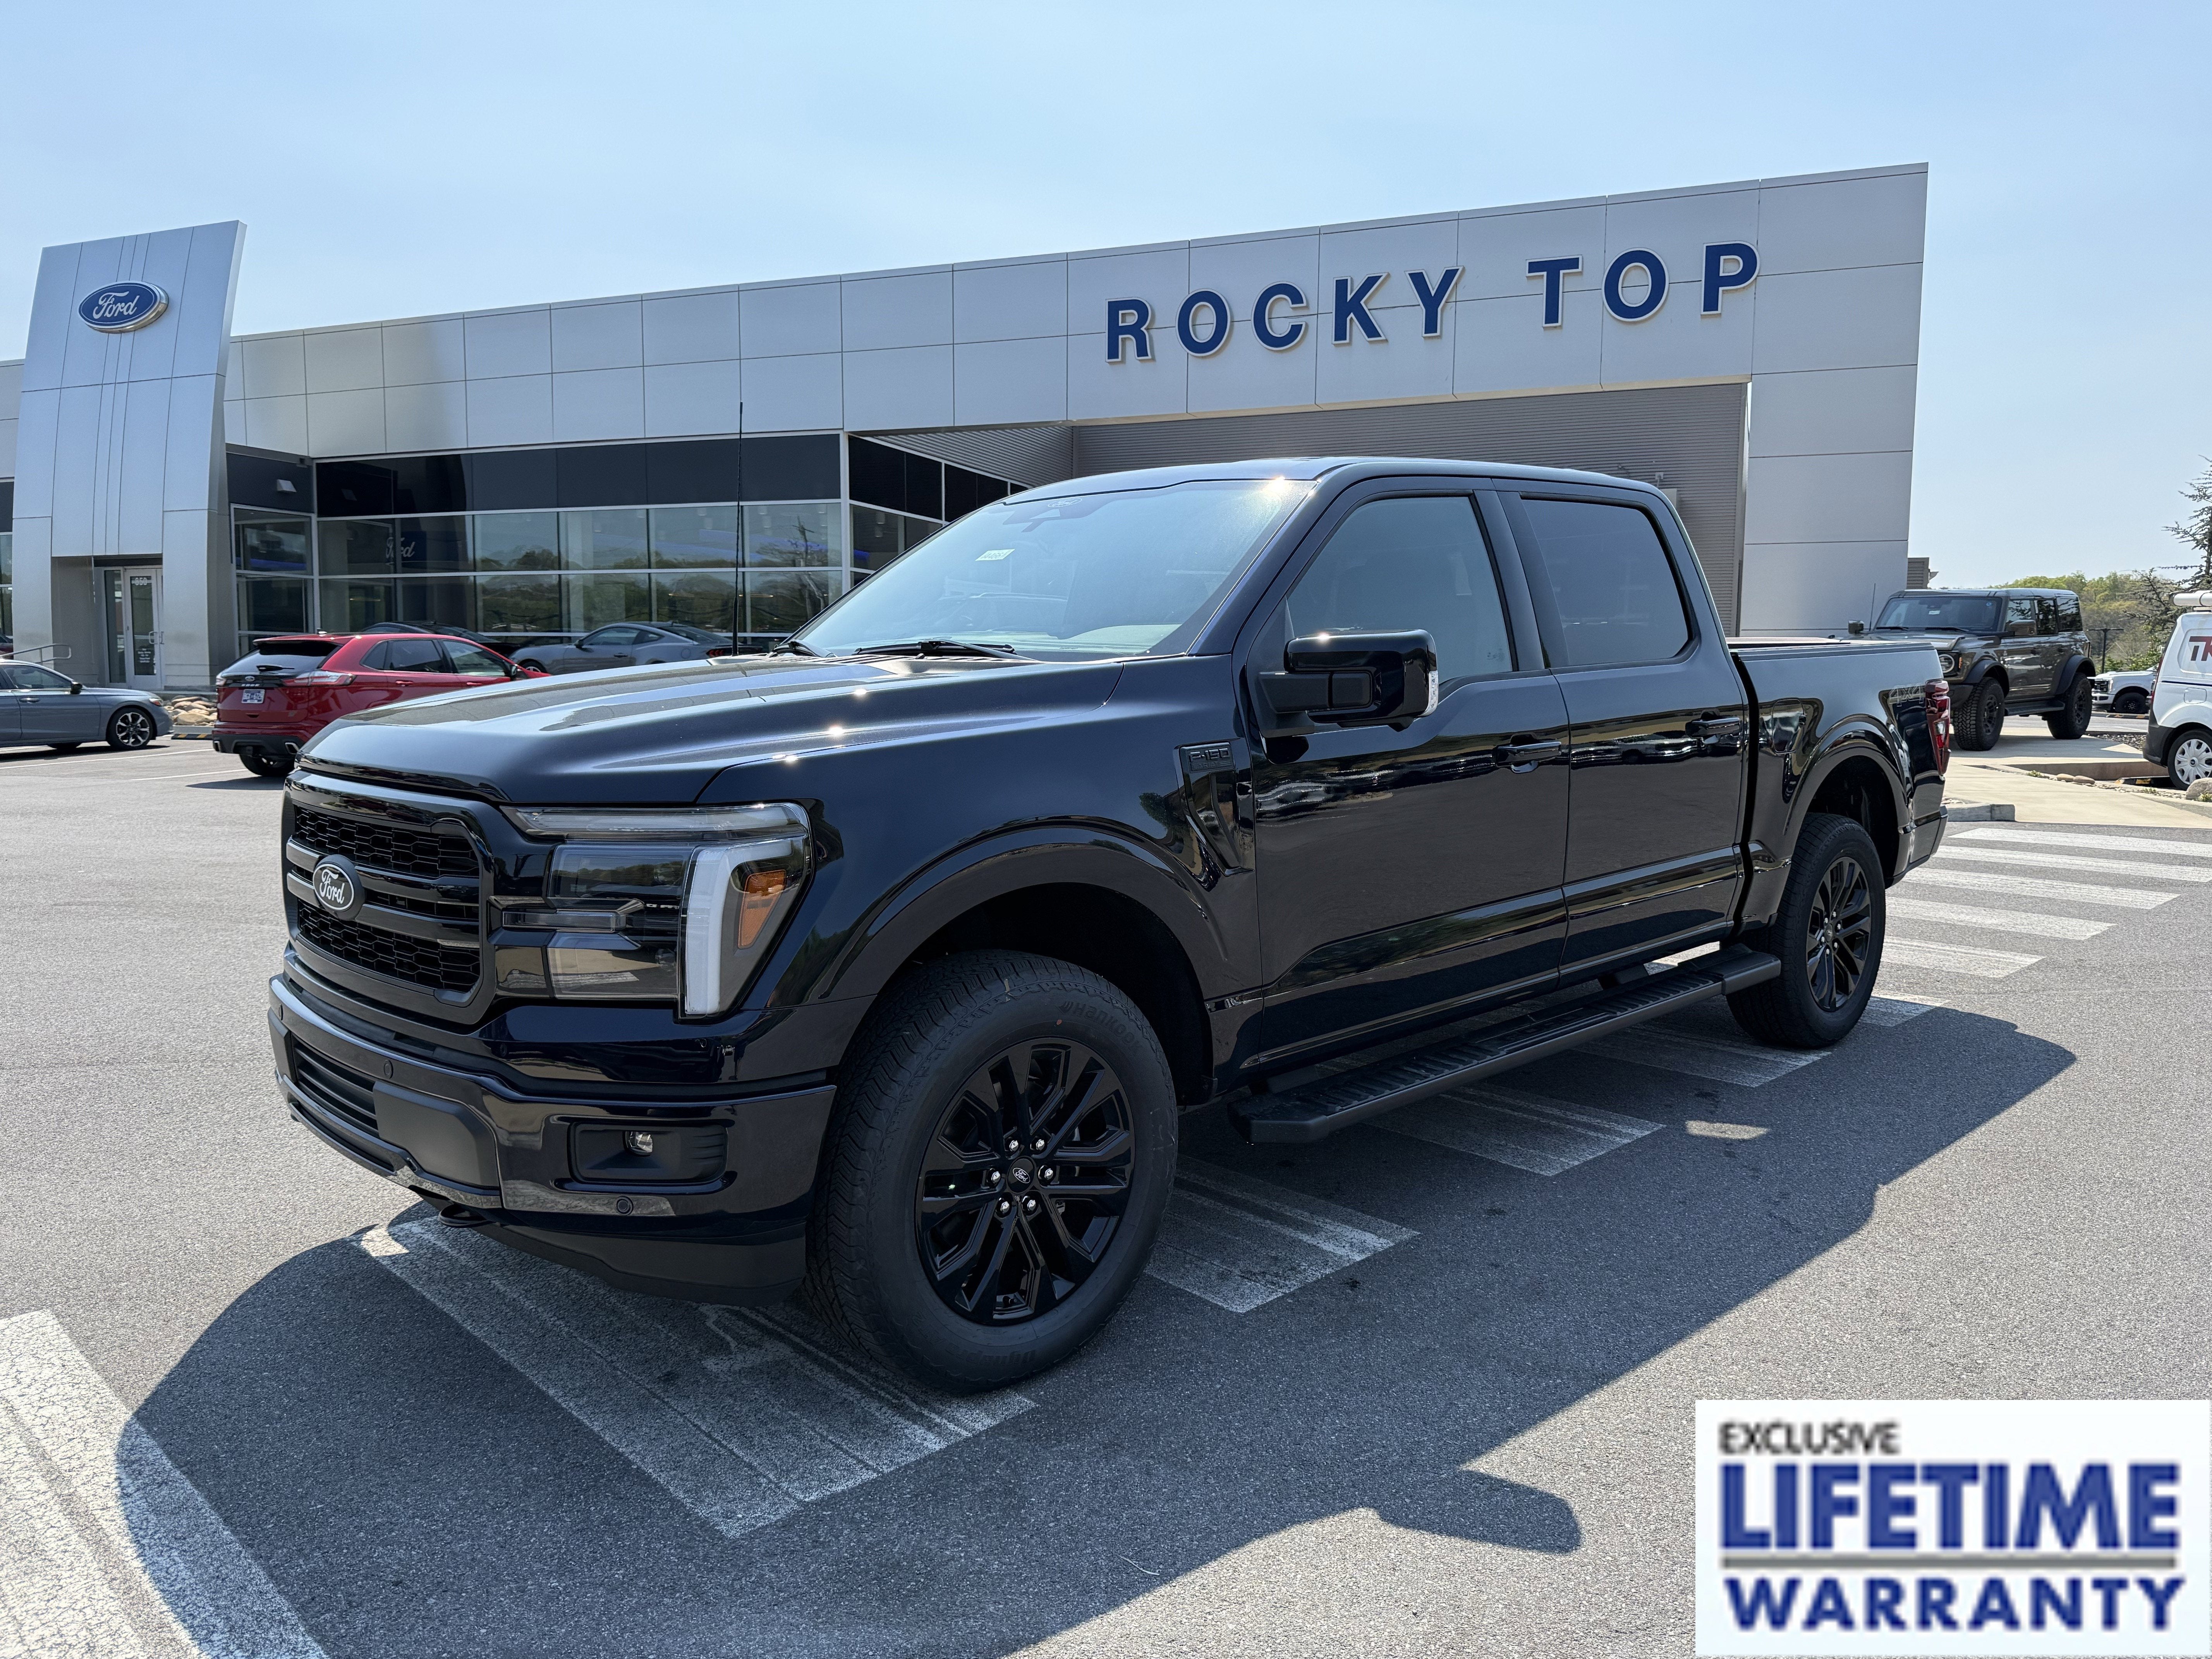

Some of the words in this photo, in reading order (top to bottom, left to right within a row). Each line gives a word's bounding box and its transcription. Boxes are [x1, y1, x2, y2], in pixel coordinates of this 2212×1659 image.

[93, 291, 140, 319] Ford
[1105, 266, 1464, 364] ROCKY
[1526, 240, 1760, 327] TOP
[1189, 748, 1230, 763] F-150
[319, 869, 345, 904] Ford
[1015, 1170, 1028, 1182] Ford
